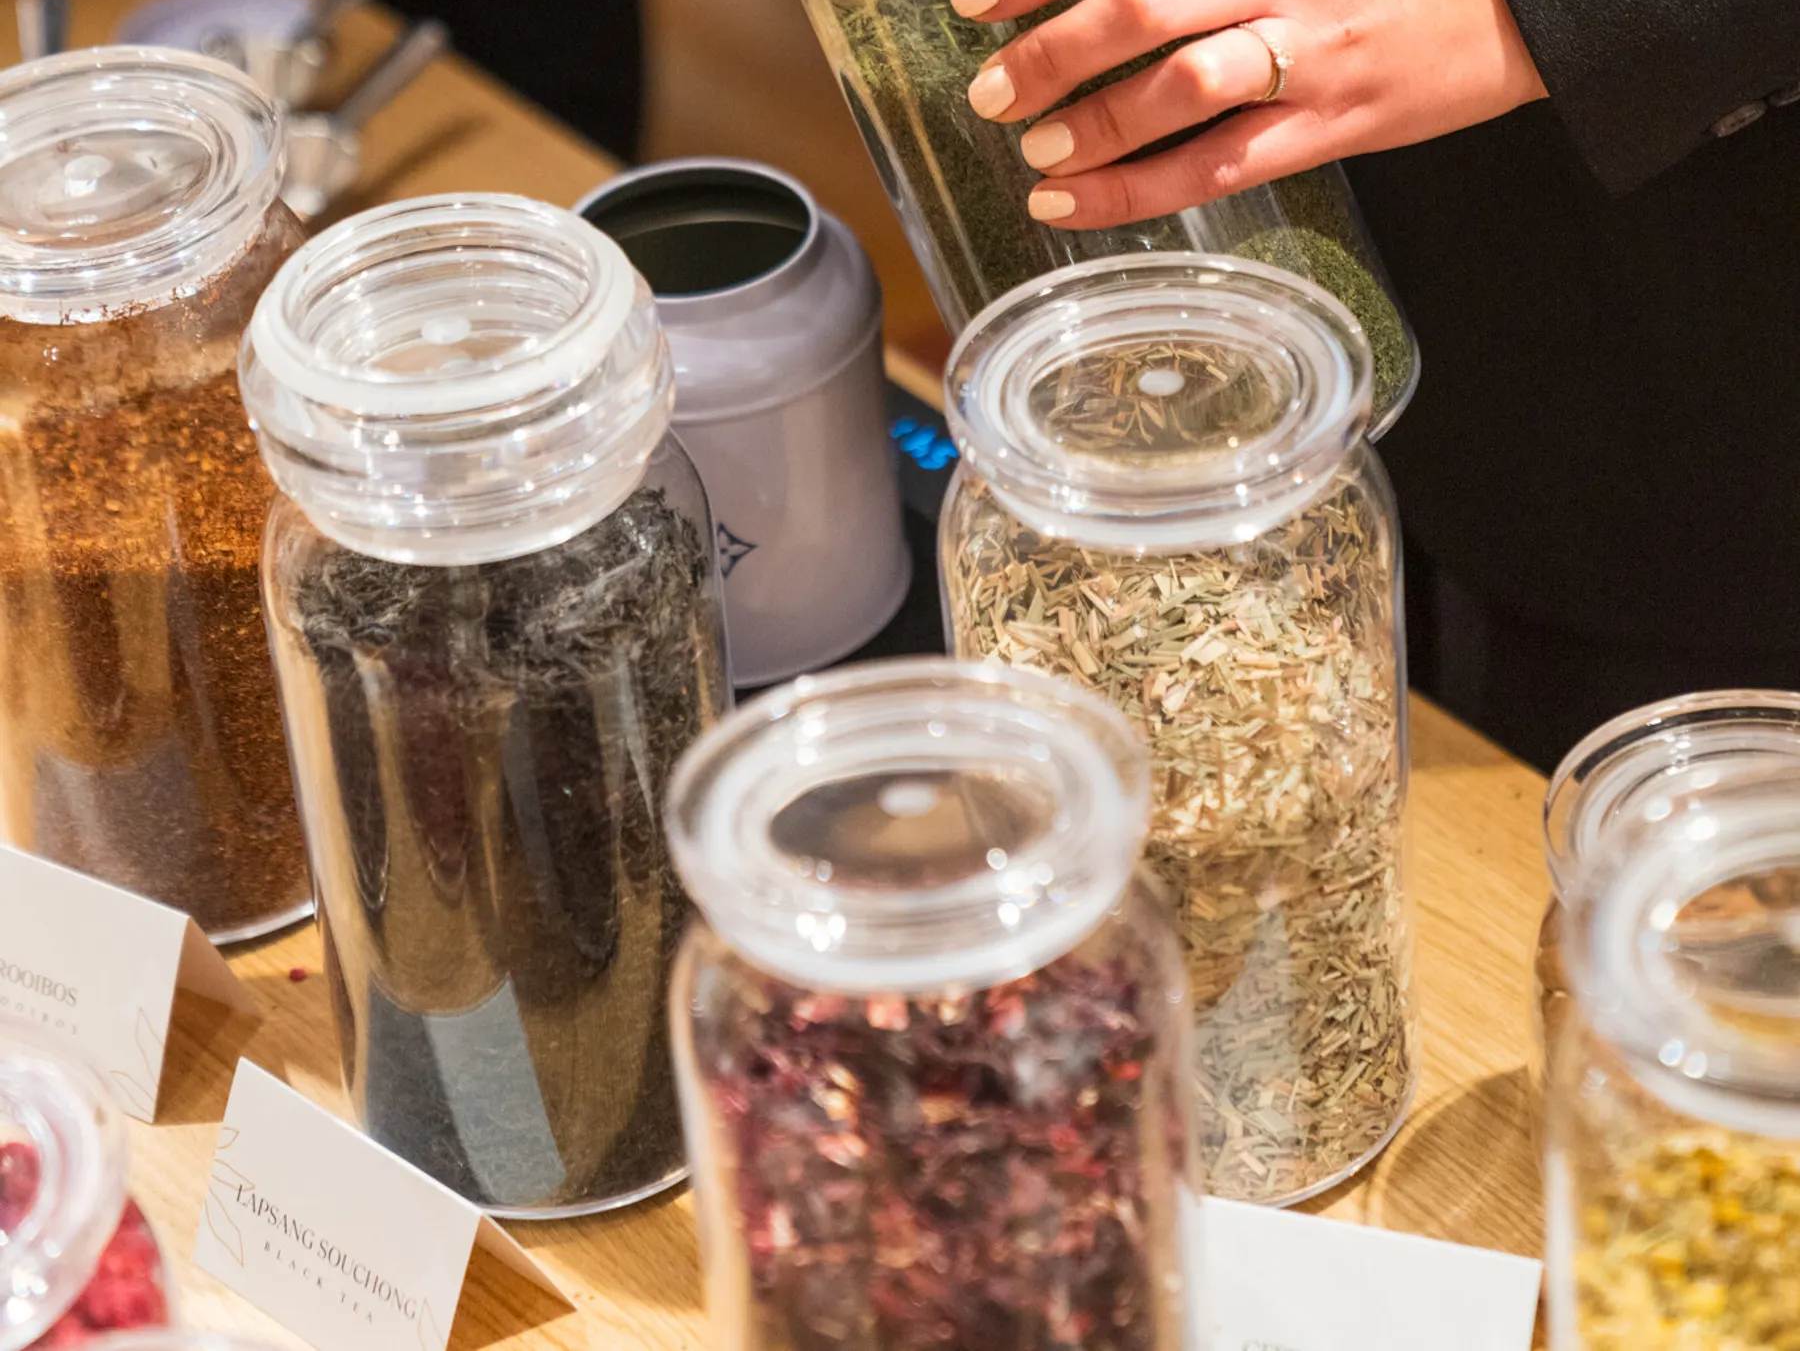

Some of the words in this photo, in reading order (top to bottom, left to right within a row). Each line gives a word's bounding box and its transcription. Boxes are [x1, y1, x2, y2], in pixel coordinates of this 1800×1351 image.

[235, 1184, 315, 1250] LAPSANG
[317, 1239, 418, 1320] SOUCHONG
[264, 1241, 323, 1289] BLACK
[340, 1291, 373, 1323] TEA
